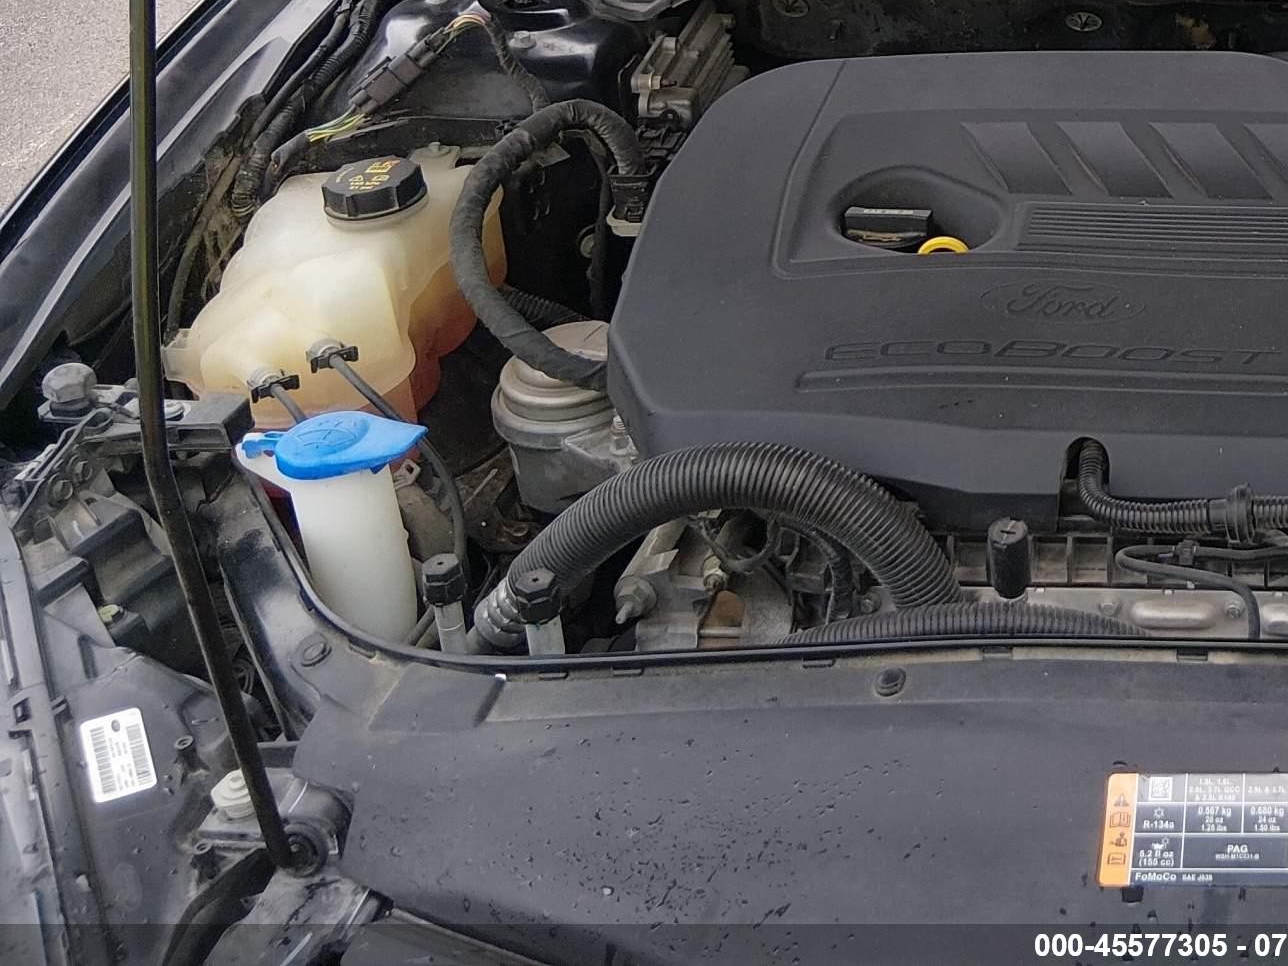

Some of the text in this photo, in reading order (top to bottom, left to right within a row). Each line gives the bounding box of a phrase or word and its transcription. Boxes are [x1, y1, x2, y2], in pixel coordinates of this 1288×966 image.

[1006, 282, 1120, 318] Ford
[1221, 806, 1232, 818] kg
[1274, 806, 1284, 818] kg
[1143, 819, 1175, 830] R-134a
[1227, 844, 1248, 853] PAG
[1135, 872, 1177, 882] FoMoCo
